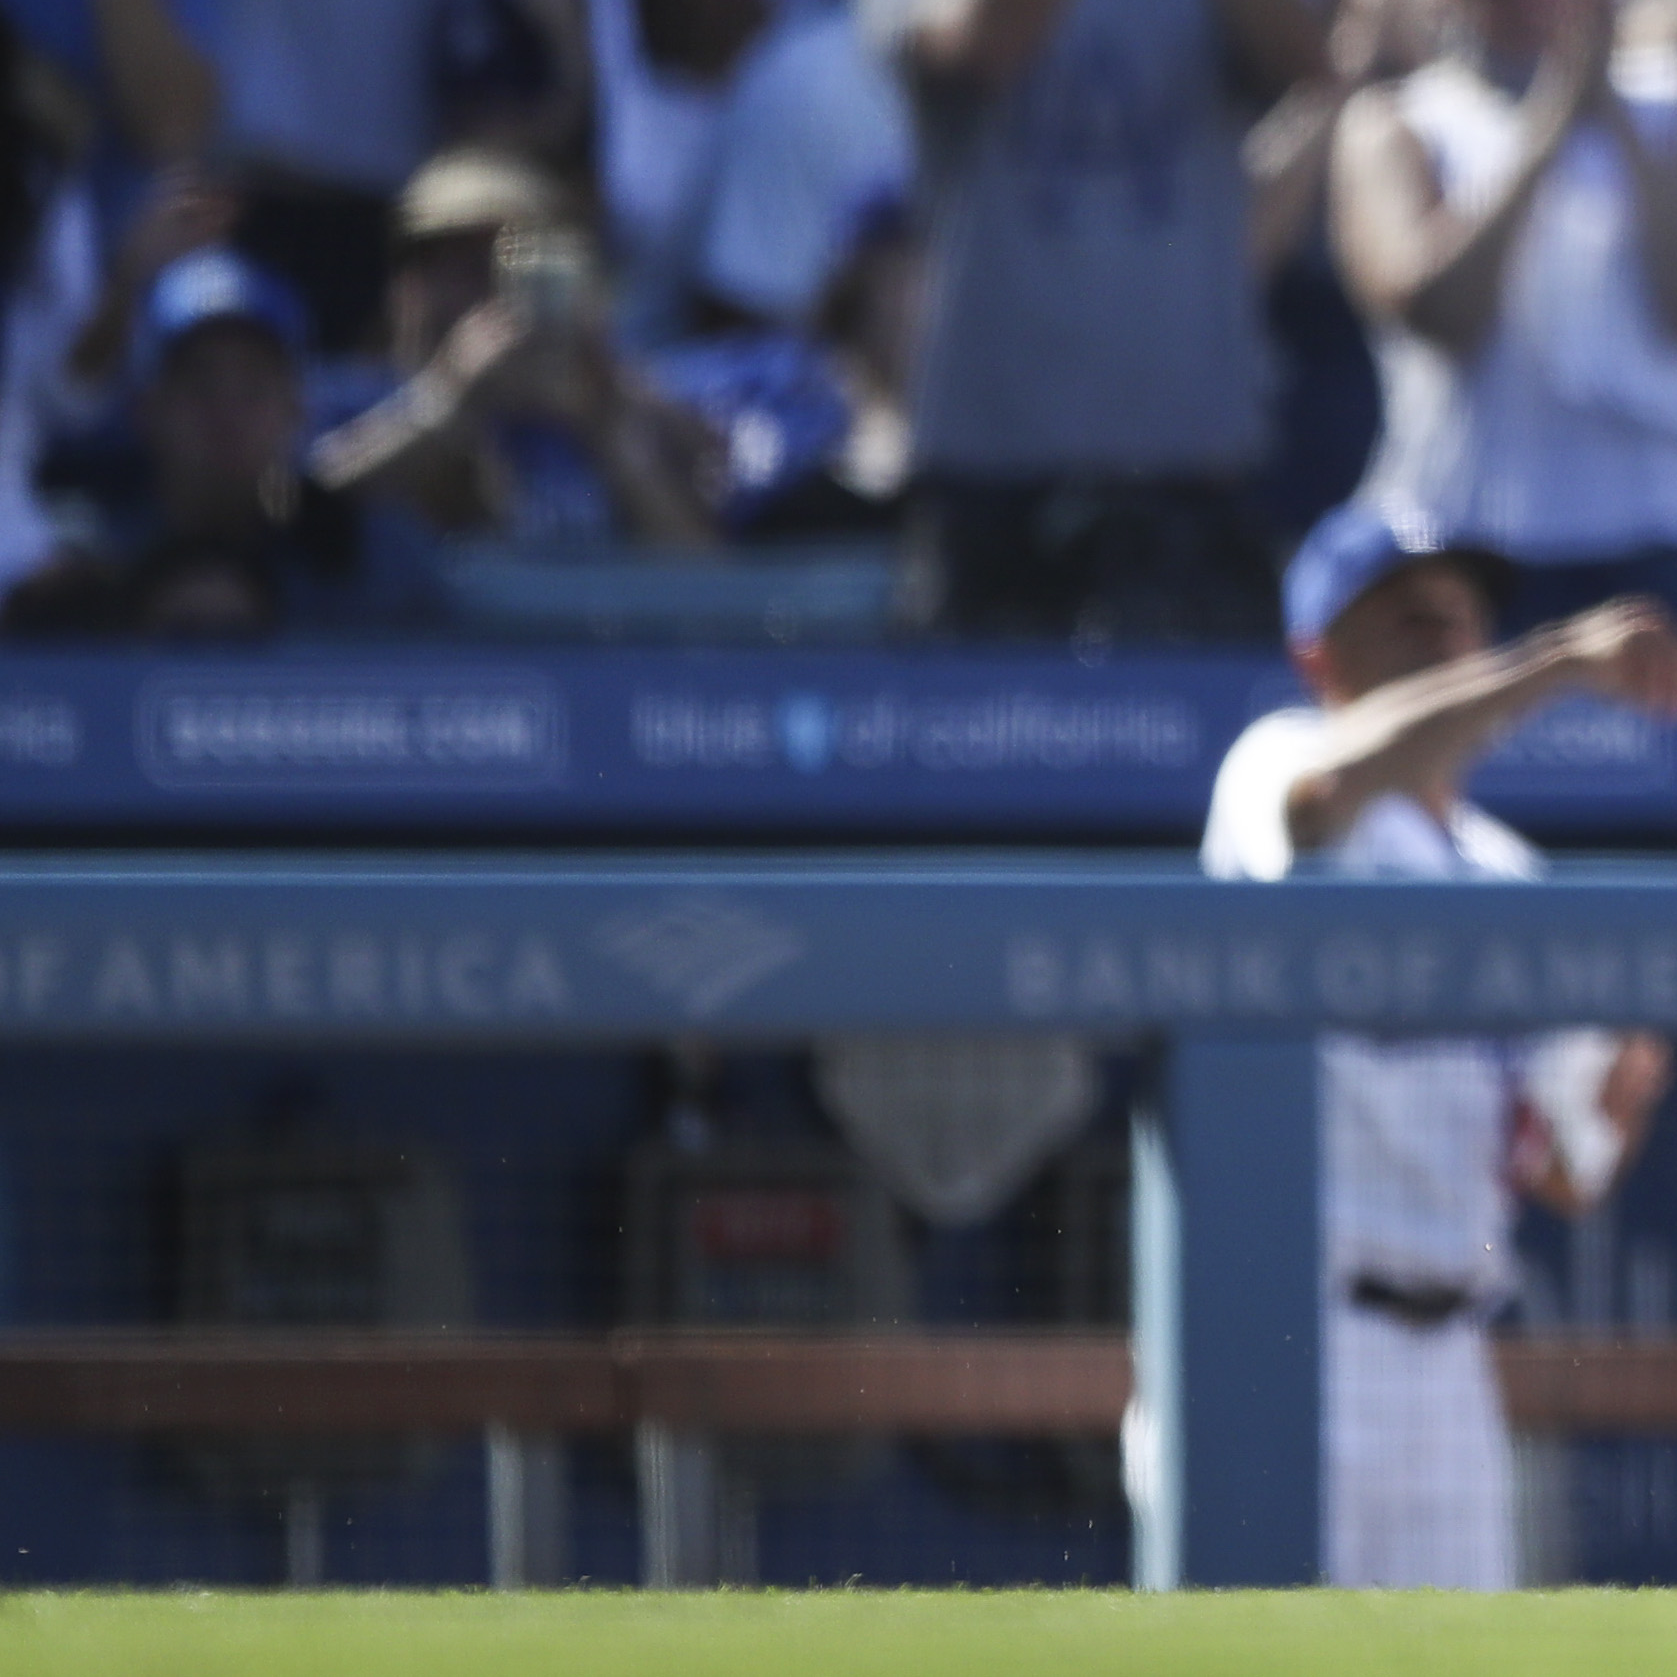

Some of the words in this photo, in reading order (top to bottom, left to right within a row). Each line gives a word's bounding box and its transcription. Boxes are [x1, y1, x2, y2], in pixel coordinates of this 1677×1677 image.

[0, 934, 80, 1018] F
[90, 934, 572, 1018] AMERICA
[1010, 932, 1298, 1020] BANK
[1322, 932, 1452, 1020] OF
